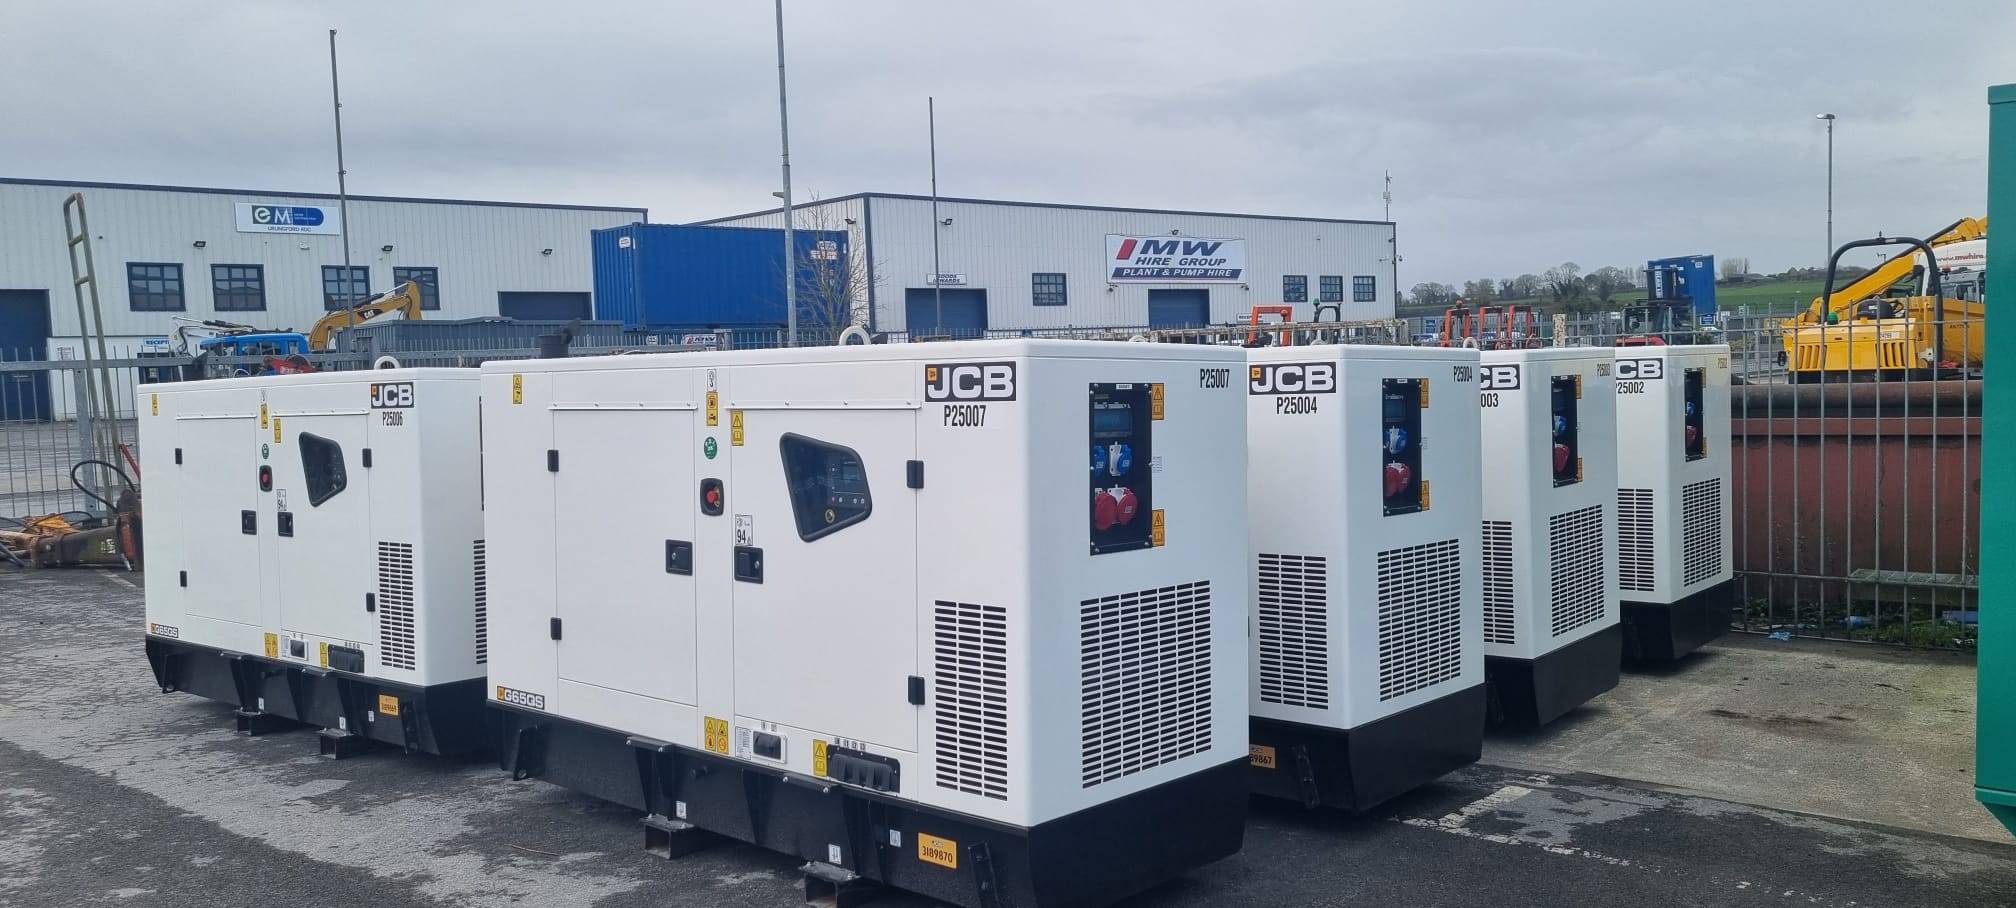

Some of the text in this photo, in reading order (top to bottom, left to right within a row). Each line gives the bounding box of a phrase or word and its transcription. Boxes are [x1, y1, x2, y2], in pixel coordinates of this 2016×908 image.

[1139, 239, 1223, 256] MW
[1135, 256, 1227, 267] HIRE GROUP
[1122, 268, 1159, 276] PLANT
[1173, 269, 1205, 277] PUMP
[363, 310, 374, 319] CAT
[927, 365, 1014, 399] JCB
[1199, 368, 1230, 389] P25007
[1251, 365, 1334, 392] JCB
[1453, 366, 1472, 382] P25004
[372, 384, 413, 407] JCB
[1616, 381, 1645, 394] 25002
[1276, 396, 1318, 415] P25004
[943, 404, 986, 427] P25007
[736, 528, 746, 544] 94
[922, 846, 953, 863] 3189870
